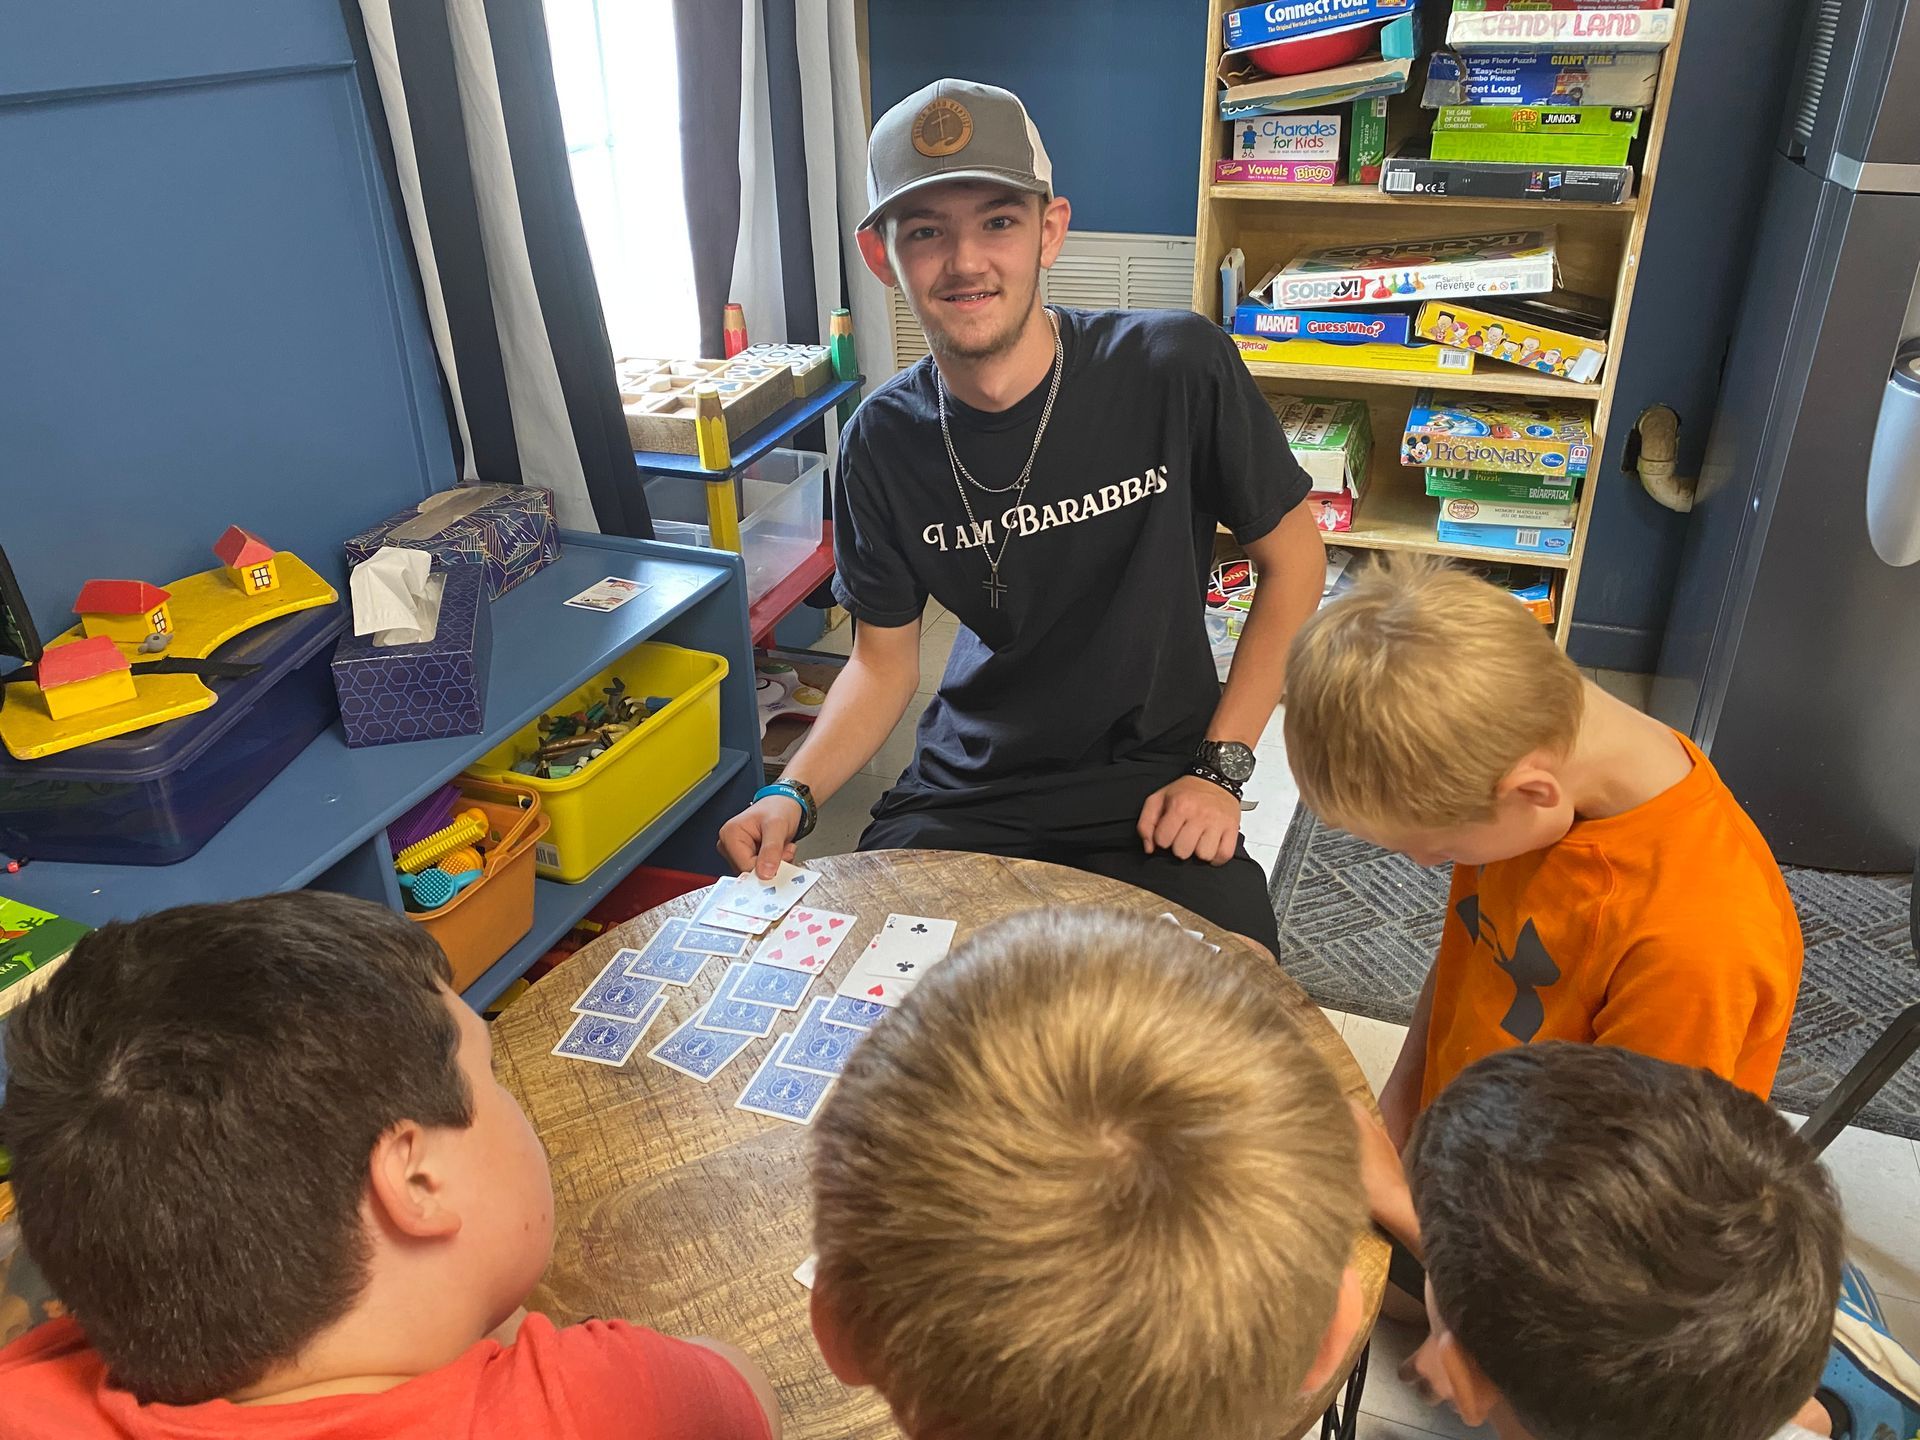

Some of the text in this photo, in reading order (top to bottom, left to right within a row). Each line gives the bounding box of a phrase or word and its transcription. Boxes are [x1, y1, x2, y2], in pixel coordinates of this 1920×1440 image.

[1264, 0, 1368, 24] Connect Fo
[1482, 13, 1641, 37] CANDY LAND
[1469, 58, 1490, 66] Large
[1491, 57, 1512, 65] Floor
[1512, 57, 1537, 65] Puzzle
[1551, 55, 1584, 65] GIANT
[1587, 55, 1612, 65] FIRE
[1464, 75, 1515, 83] Jumbo Pieces
[1465, 85, 1489, 95] Feet
[1491, 84, 1521, 97] Long!
[1545, 114, 1577, 124] JUNIOR
[1262, 120, 1337, 138] Charades
[1273, 136, 1324, 149] for Kids
[1248, 163, 1288, 177] Vowels
[1295, 166, 1332, 180] Bingo
[1288, 280, 1358, 299] SORRY!
[1435, 280, 1475, 292] Revenge
[1255, 315, 1299, 334] MARVEL
[1308, 321, 1385, 337] Guess Who?
[1236, 341, 1269, 351] ERATION
[922, 465, 1168, 551] I AM BARABBAS
[1222, 570, 1249, 582] UNO
